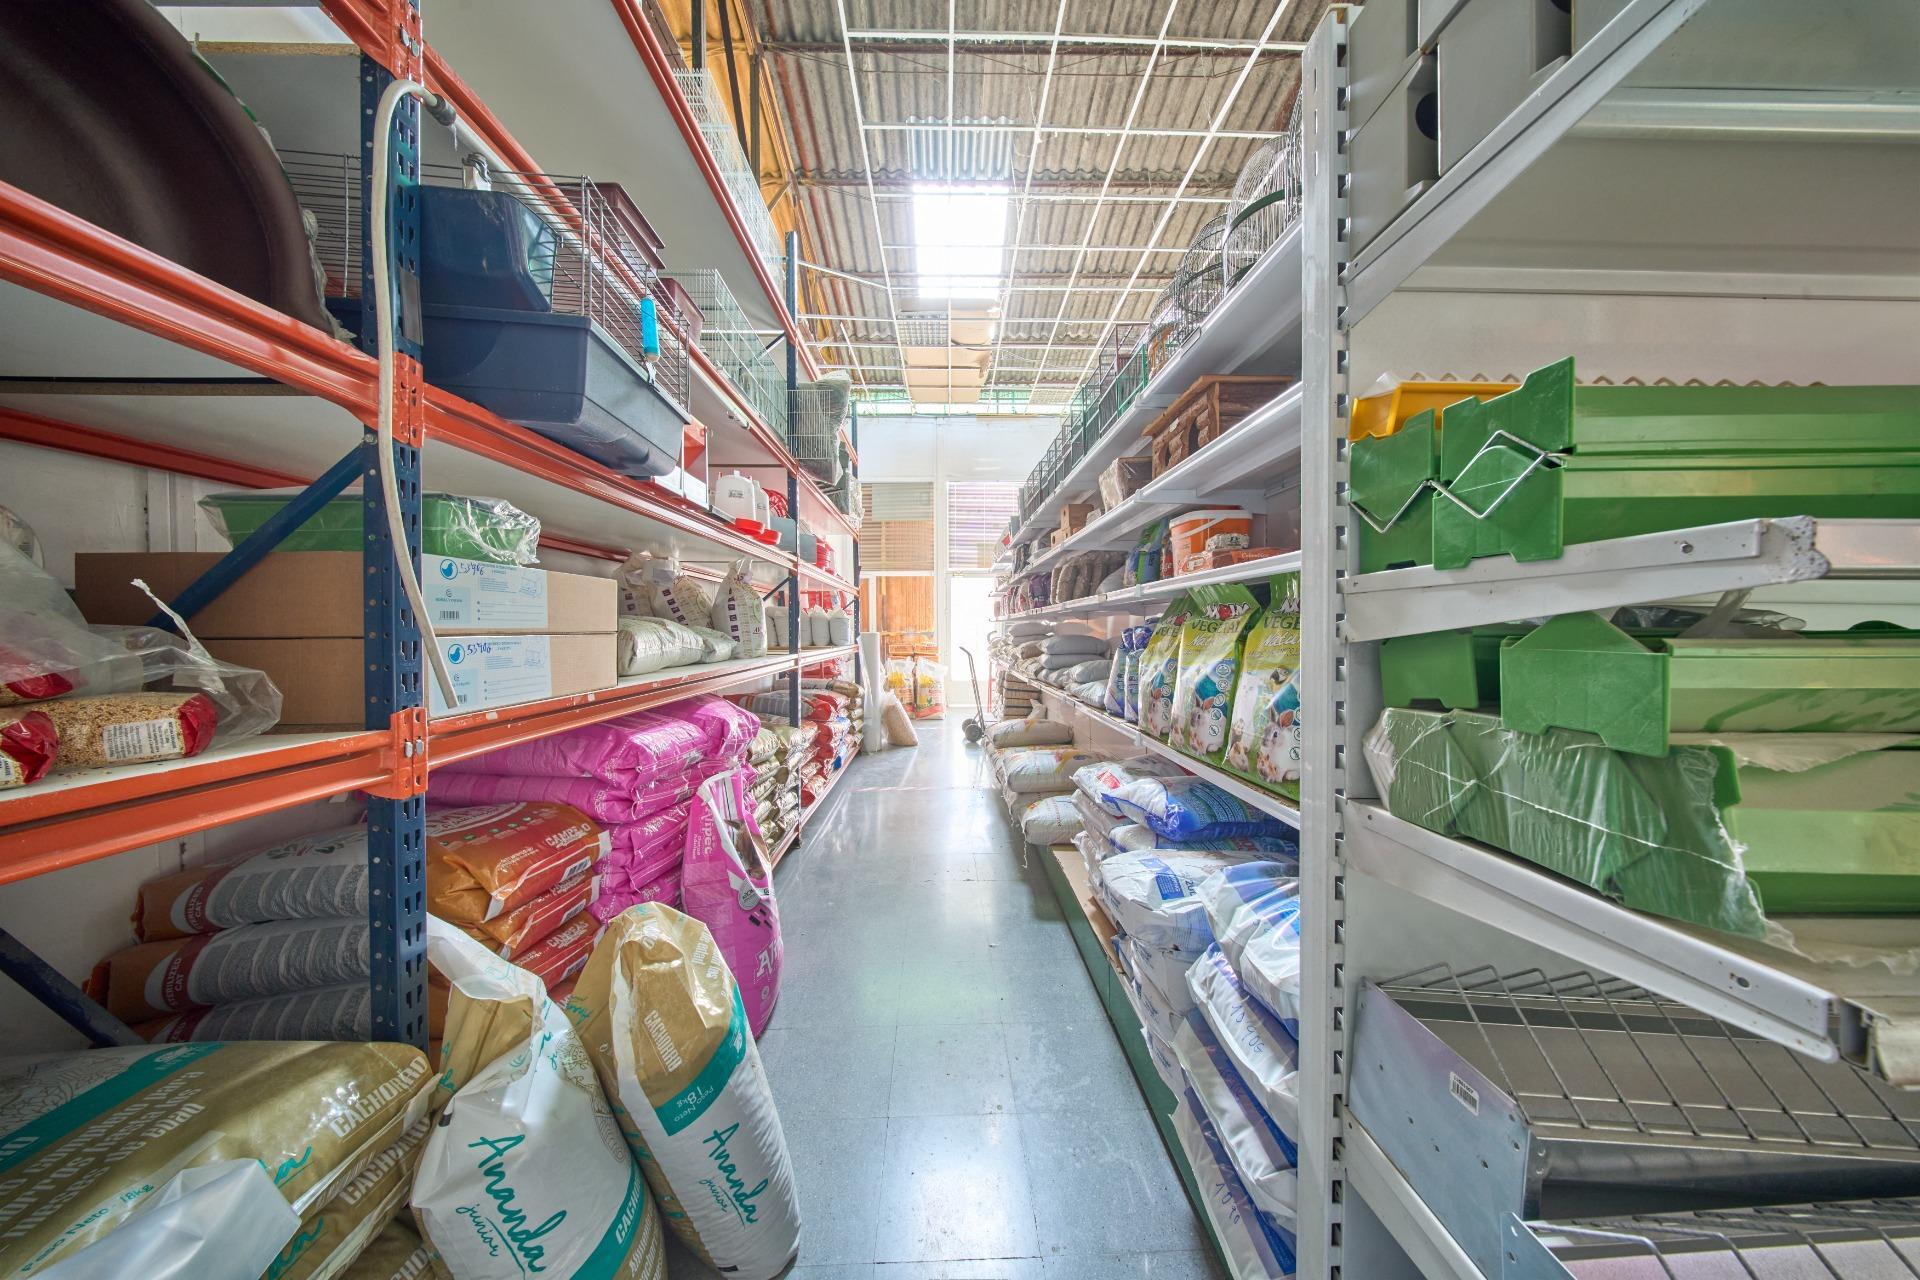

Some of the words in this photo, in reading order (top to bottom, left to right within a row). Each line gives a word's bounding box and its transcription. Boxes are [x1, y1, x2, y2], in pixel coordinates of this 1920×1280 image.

[545, 822, 592, 847] CAMPEO
[166, 957, 182, 1007] STERILIZED
[175, 974, 184, 992] CAT
[643, 1009, 683, 1073] CACHORRO
[328, 1056, 428, 1138] CACHORRO
[673, 1103, 697, 1123] Neto
[698, 1176, 728, 1213] junior
[703, 1122, 769, 1224] Ananda
[66, 1207, 110, 1236] Neto
[119, 1183, 155, 1204] 18kg
[467, 1133, 568, 1273] Ananda
[455, 1203, 500, 1257] junior
